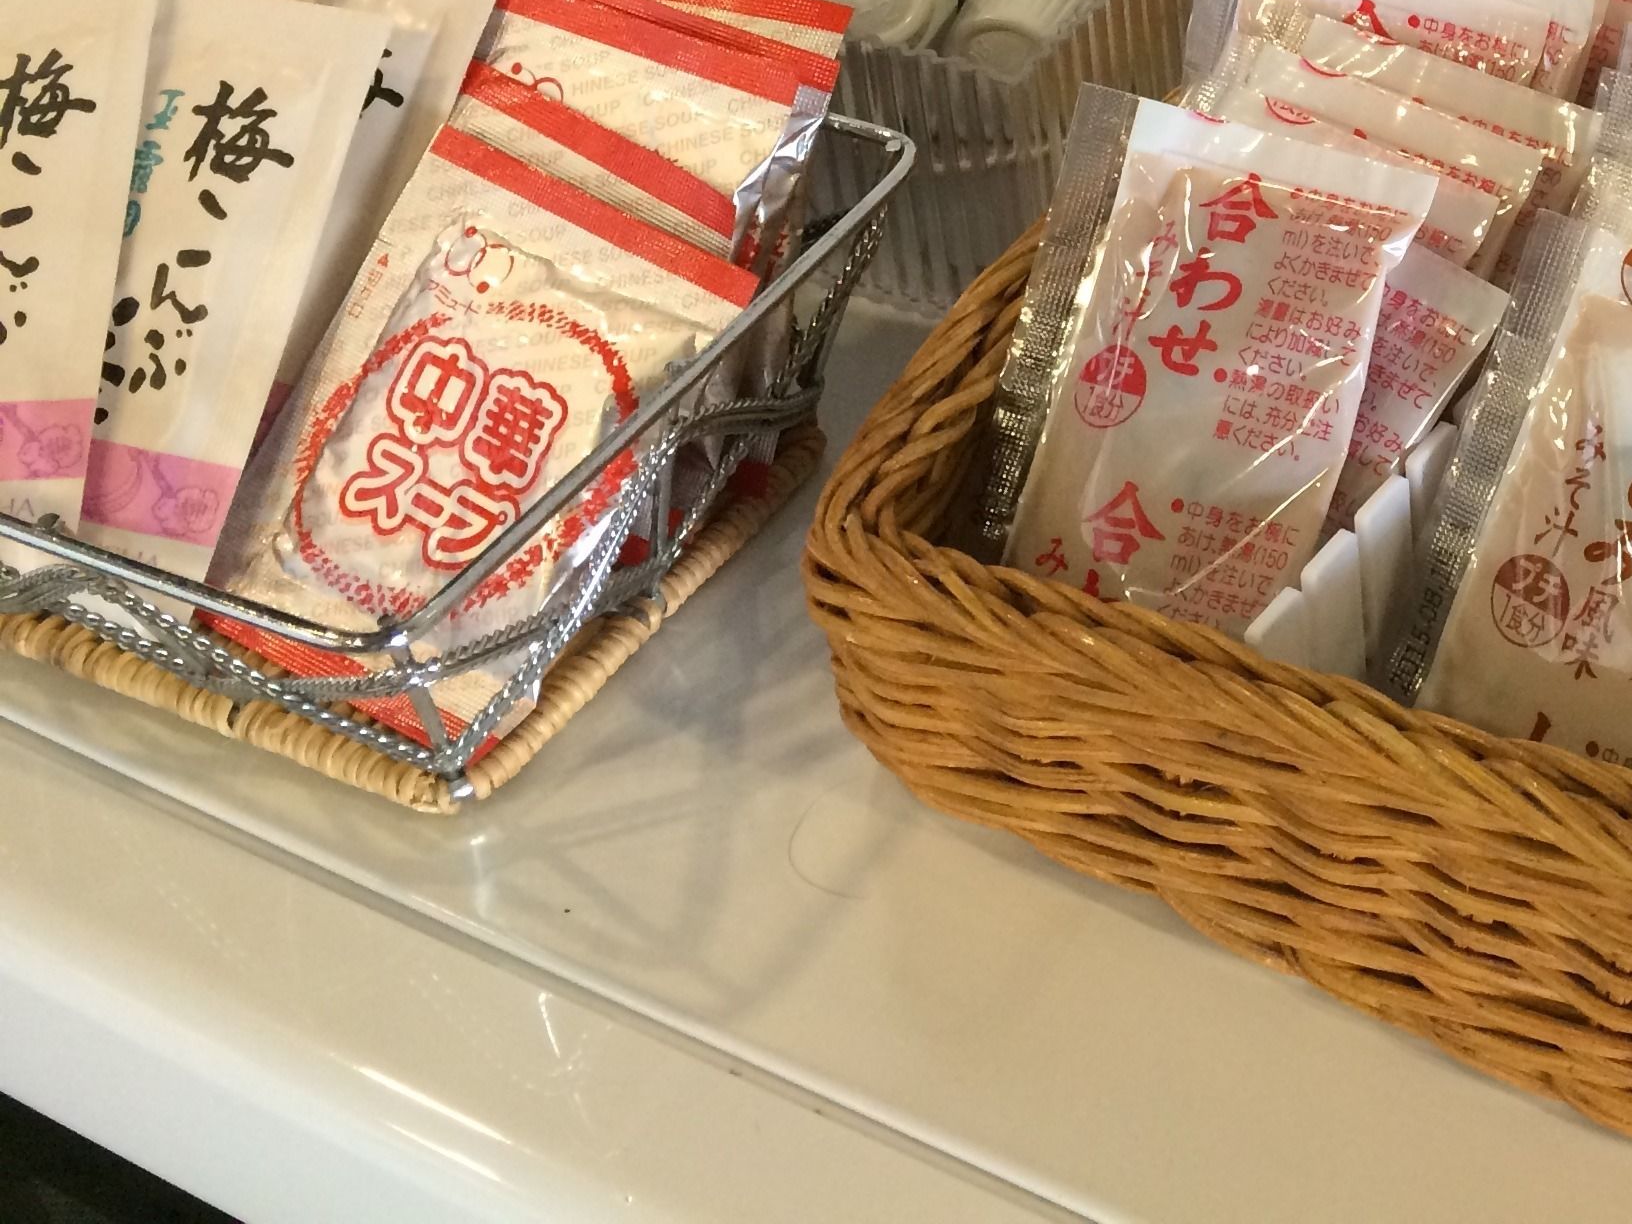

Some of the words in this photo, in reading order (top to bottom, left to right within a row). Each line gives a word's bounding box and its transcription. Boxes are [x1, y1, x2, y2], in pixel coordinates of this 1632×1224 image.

[128, 79, 295, 399] 梅こんぶ
[1148, 172, 1279, 376] 合わせ
[1254, 296, 1362, 339] 湯量はお好み
[1267, 275, 1329, 309] ください。
[1228, 368, 1341, 415] 熱湯の取扱い
[1238, 344, 1308, 382] ください。
[388, 339, 566, 494] 中華
[341, 432, 520, 570] スープ
[1187, 501, 1300, 548] 中身をお椀に
[1533, 424, 1607, 559] みそ汁
